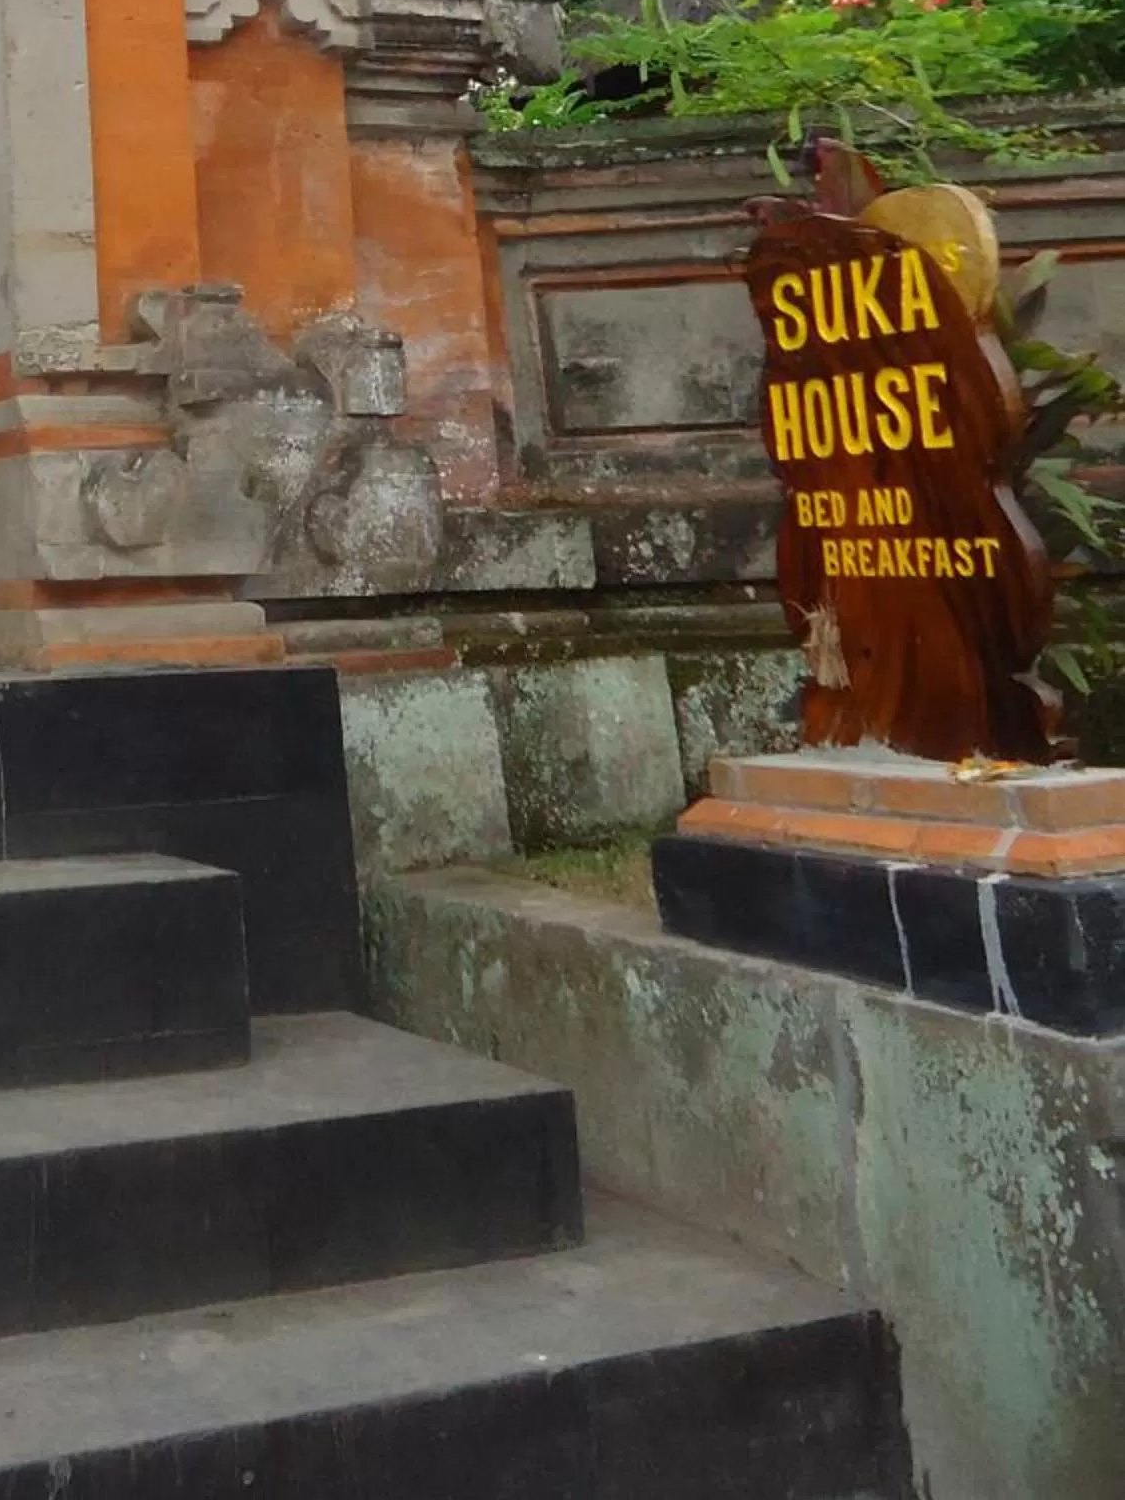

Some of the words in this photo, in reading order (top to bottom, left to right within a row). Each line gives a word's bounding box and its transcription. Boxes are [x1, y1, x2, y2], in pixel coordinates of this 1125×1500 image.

[769, 363, 954, 461] HOUSE
[797, 490, 846, 528] BED
[857, 487, 913, 526] AND
[822, 537, 1000, 578] BREAKFAST
